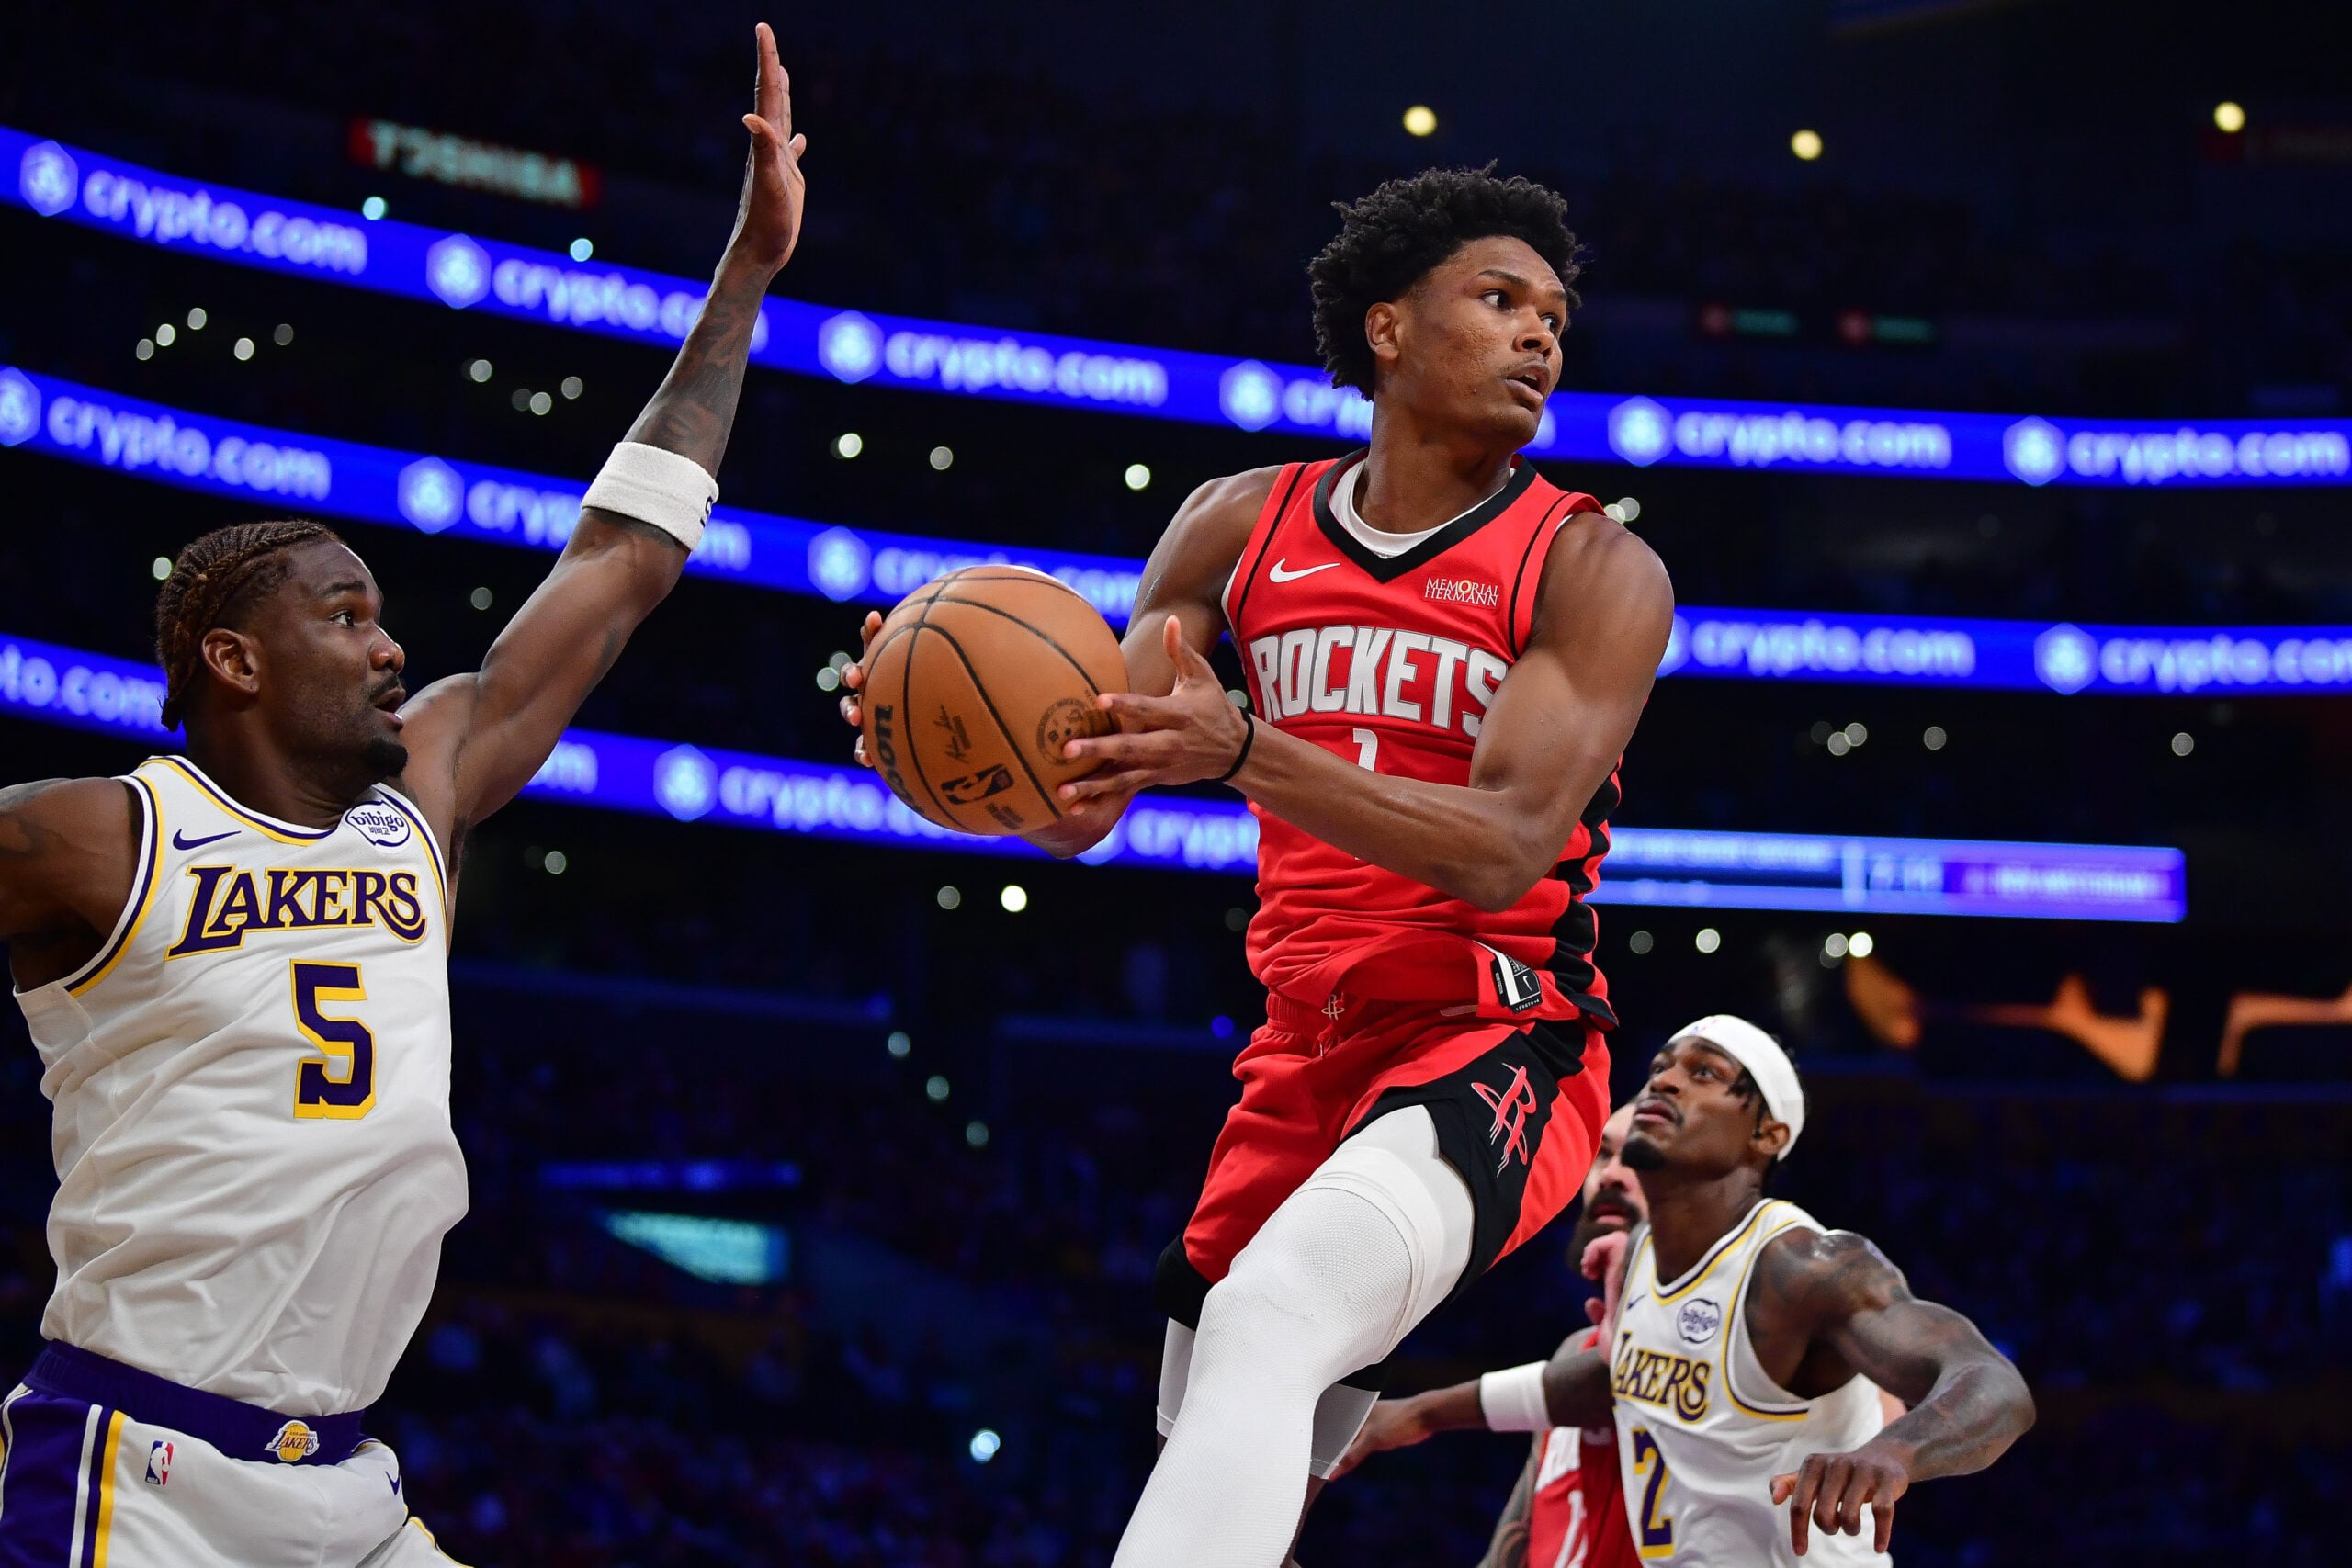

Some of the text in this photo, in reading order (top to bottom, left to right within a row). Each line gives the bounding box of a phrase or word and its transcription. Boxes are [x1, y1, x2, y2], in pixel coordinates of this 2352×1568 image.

[83, 170, 368, 275] crypto.com
[885, 331, 1169, 407] crypto.com
[47, 396, 332, 501] crypto.com
[1674, 411, 1952, 469] crypto.com
[2067, 427, 2350, 485] crypto.com
[1424, 588, 1499, 606] HERMANN
[1426, 577, 1499, 597] MEMORIAL
[1692, 619, 1975, 677] crypto.com
[1250, 625, 1509, 739] ROCKETS
[350, 811, 404, 832] bibigo
[164, 863, 428, 962] LAKERS
[289, 958, 377, 1120] 5
[266, 1430, 319, 1455] LAKERS
[1632, 1427, 1675, 1559] 2
